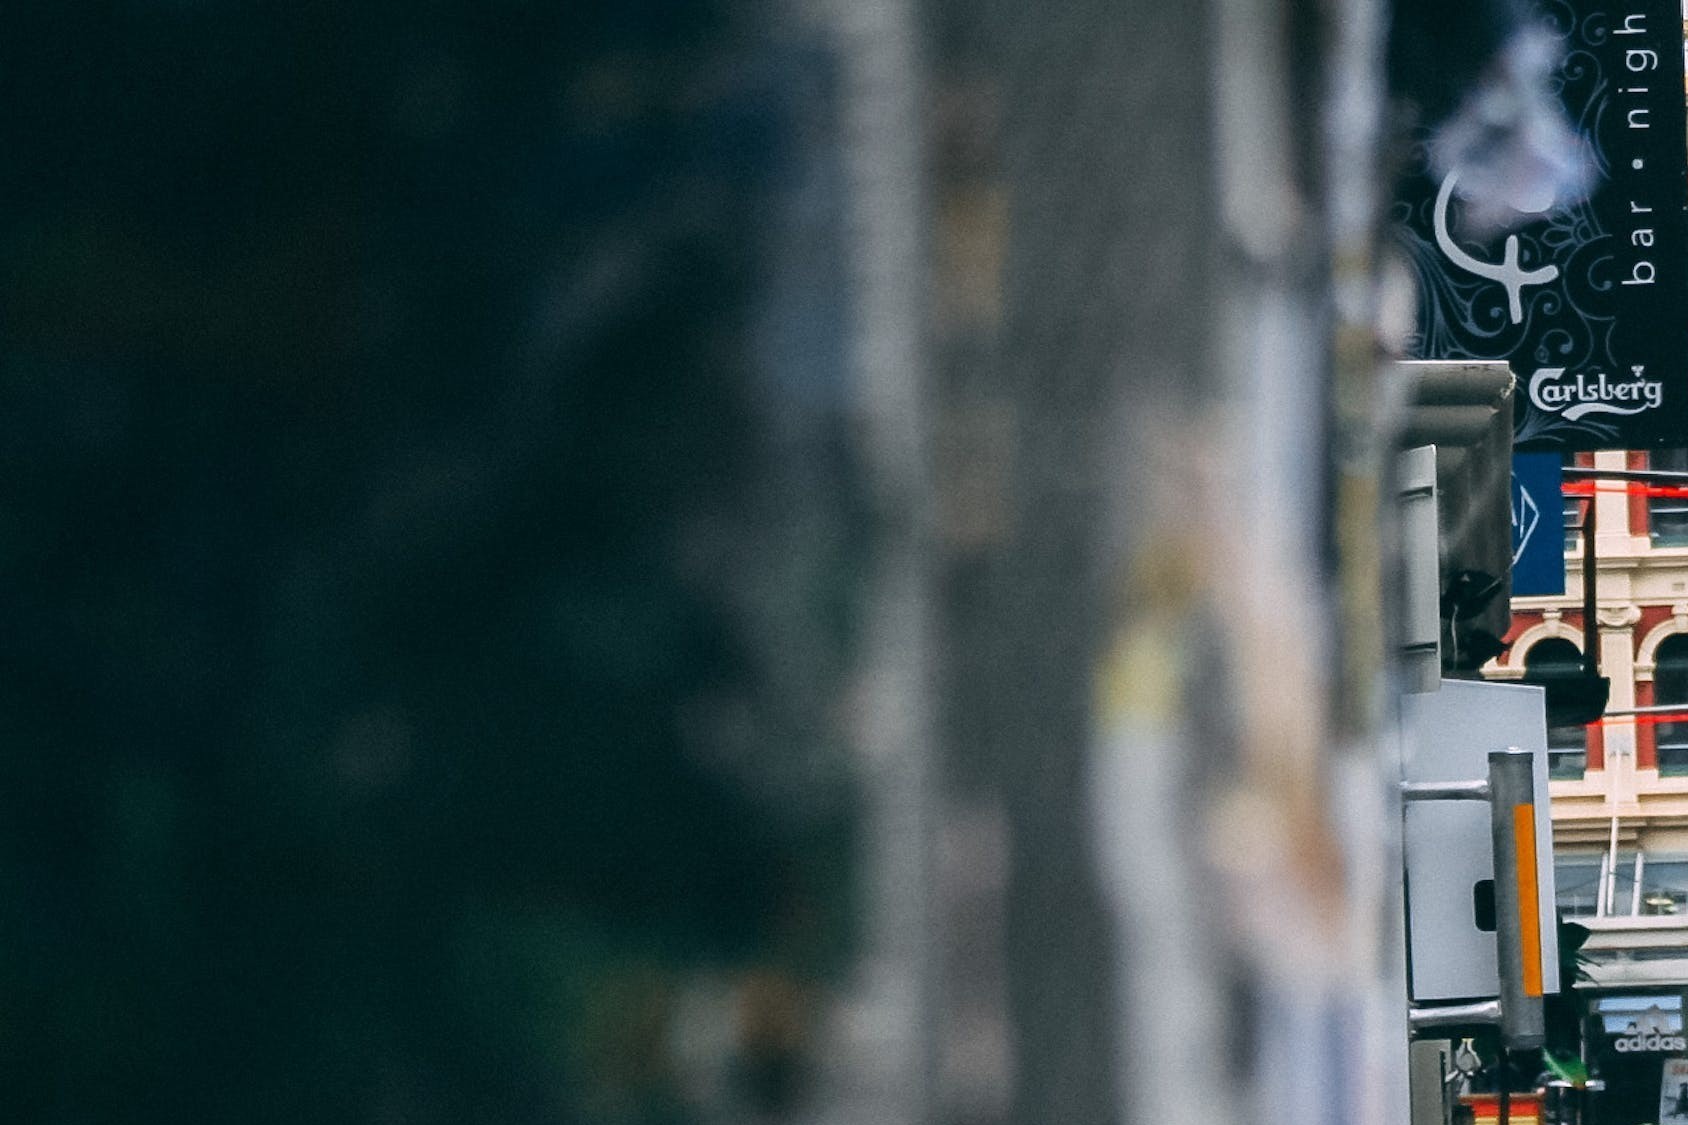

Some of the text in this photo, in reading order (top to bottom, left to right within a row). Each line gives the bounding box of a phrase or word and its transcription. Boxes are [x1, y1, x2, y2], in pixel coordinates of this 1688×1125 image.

[1622, 200, 1656, 286] bar
[1528, 366, 1663, 418] Carlsberg
[1615, 1032, 1686, 1052] adidas
